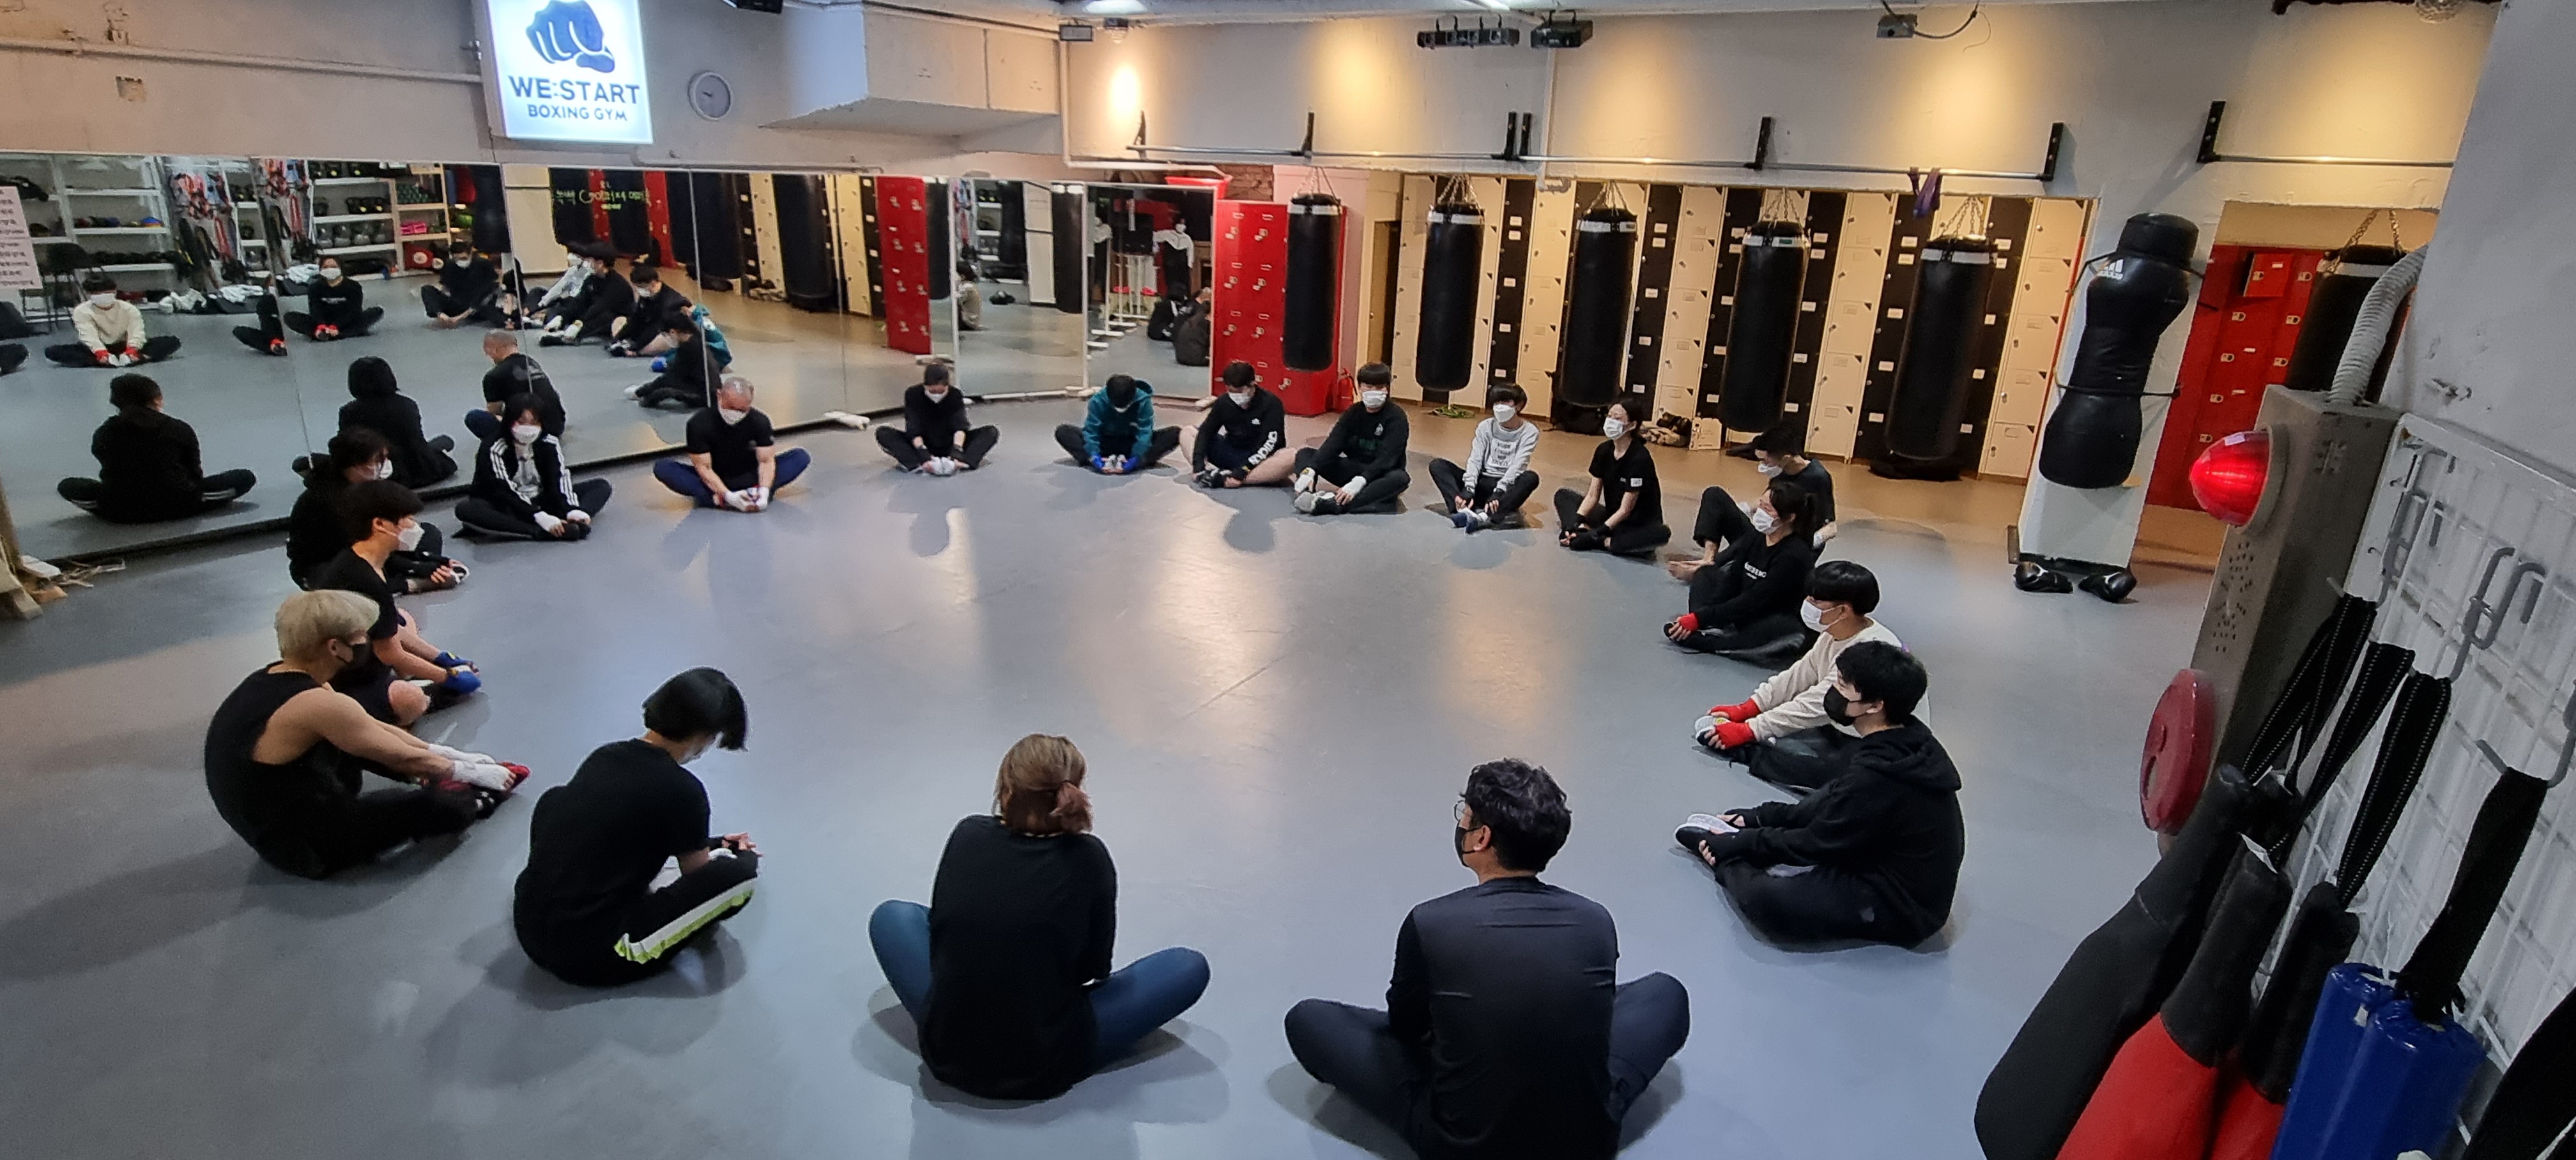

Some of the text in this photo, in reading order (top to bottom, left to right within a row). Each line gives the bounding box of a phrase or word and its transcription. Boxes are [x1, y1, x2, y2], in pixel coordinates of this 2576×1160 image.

[508, 75, 640, 105] WE:START
[527, 103, 627, 121] BOXING GYM
